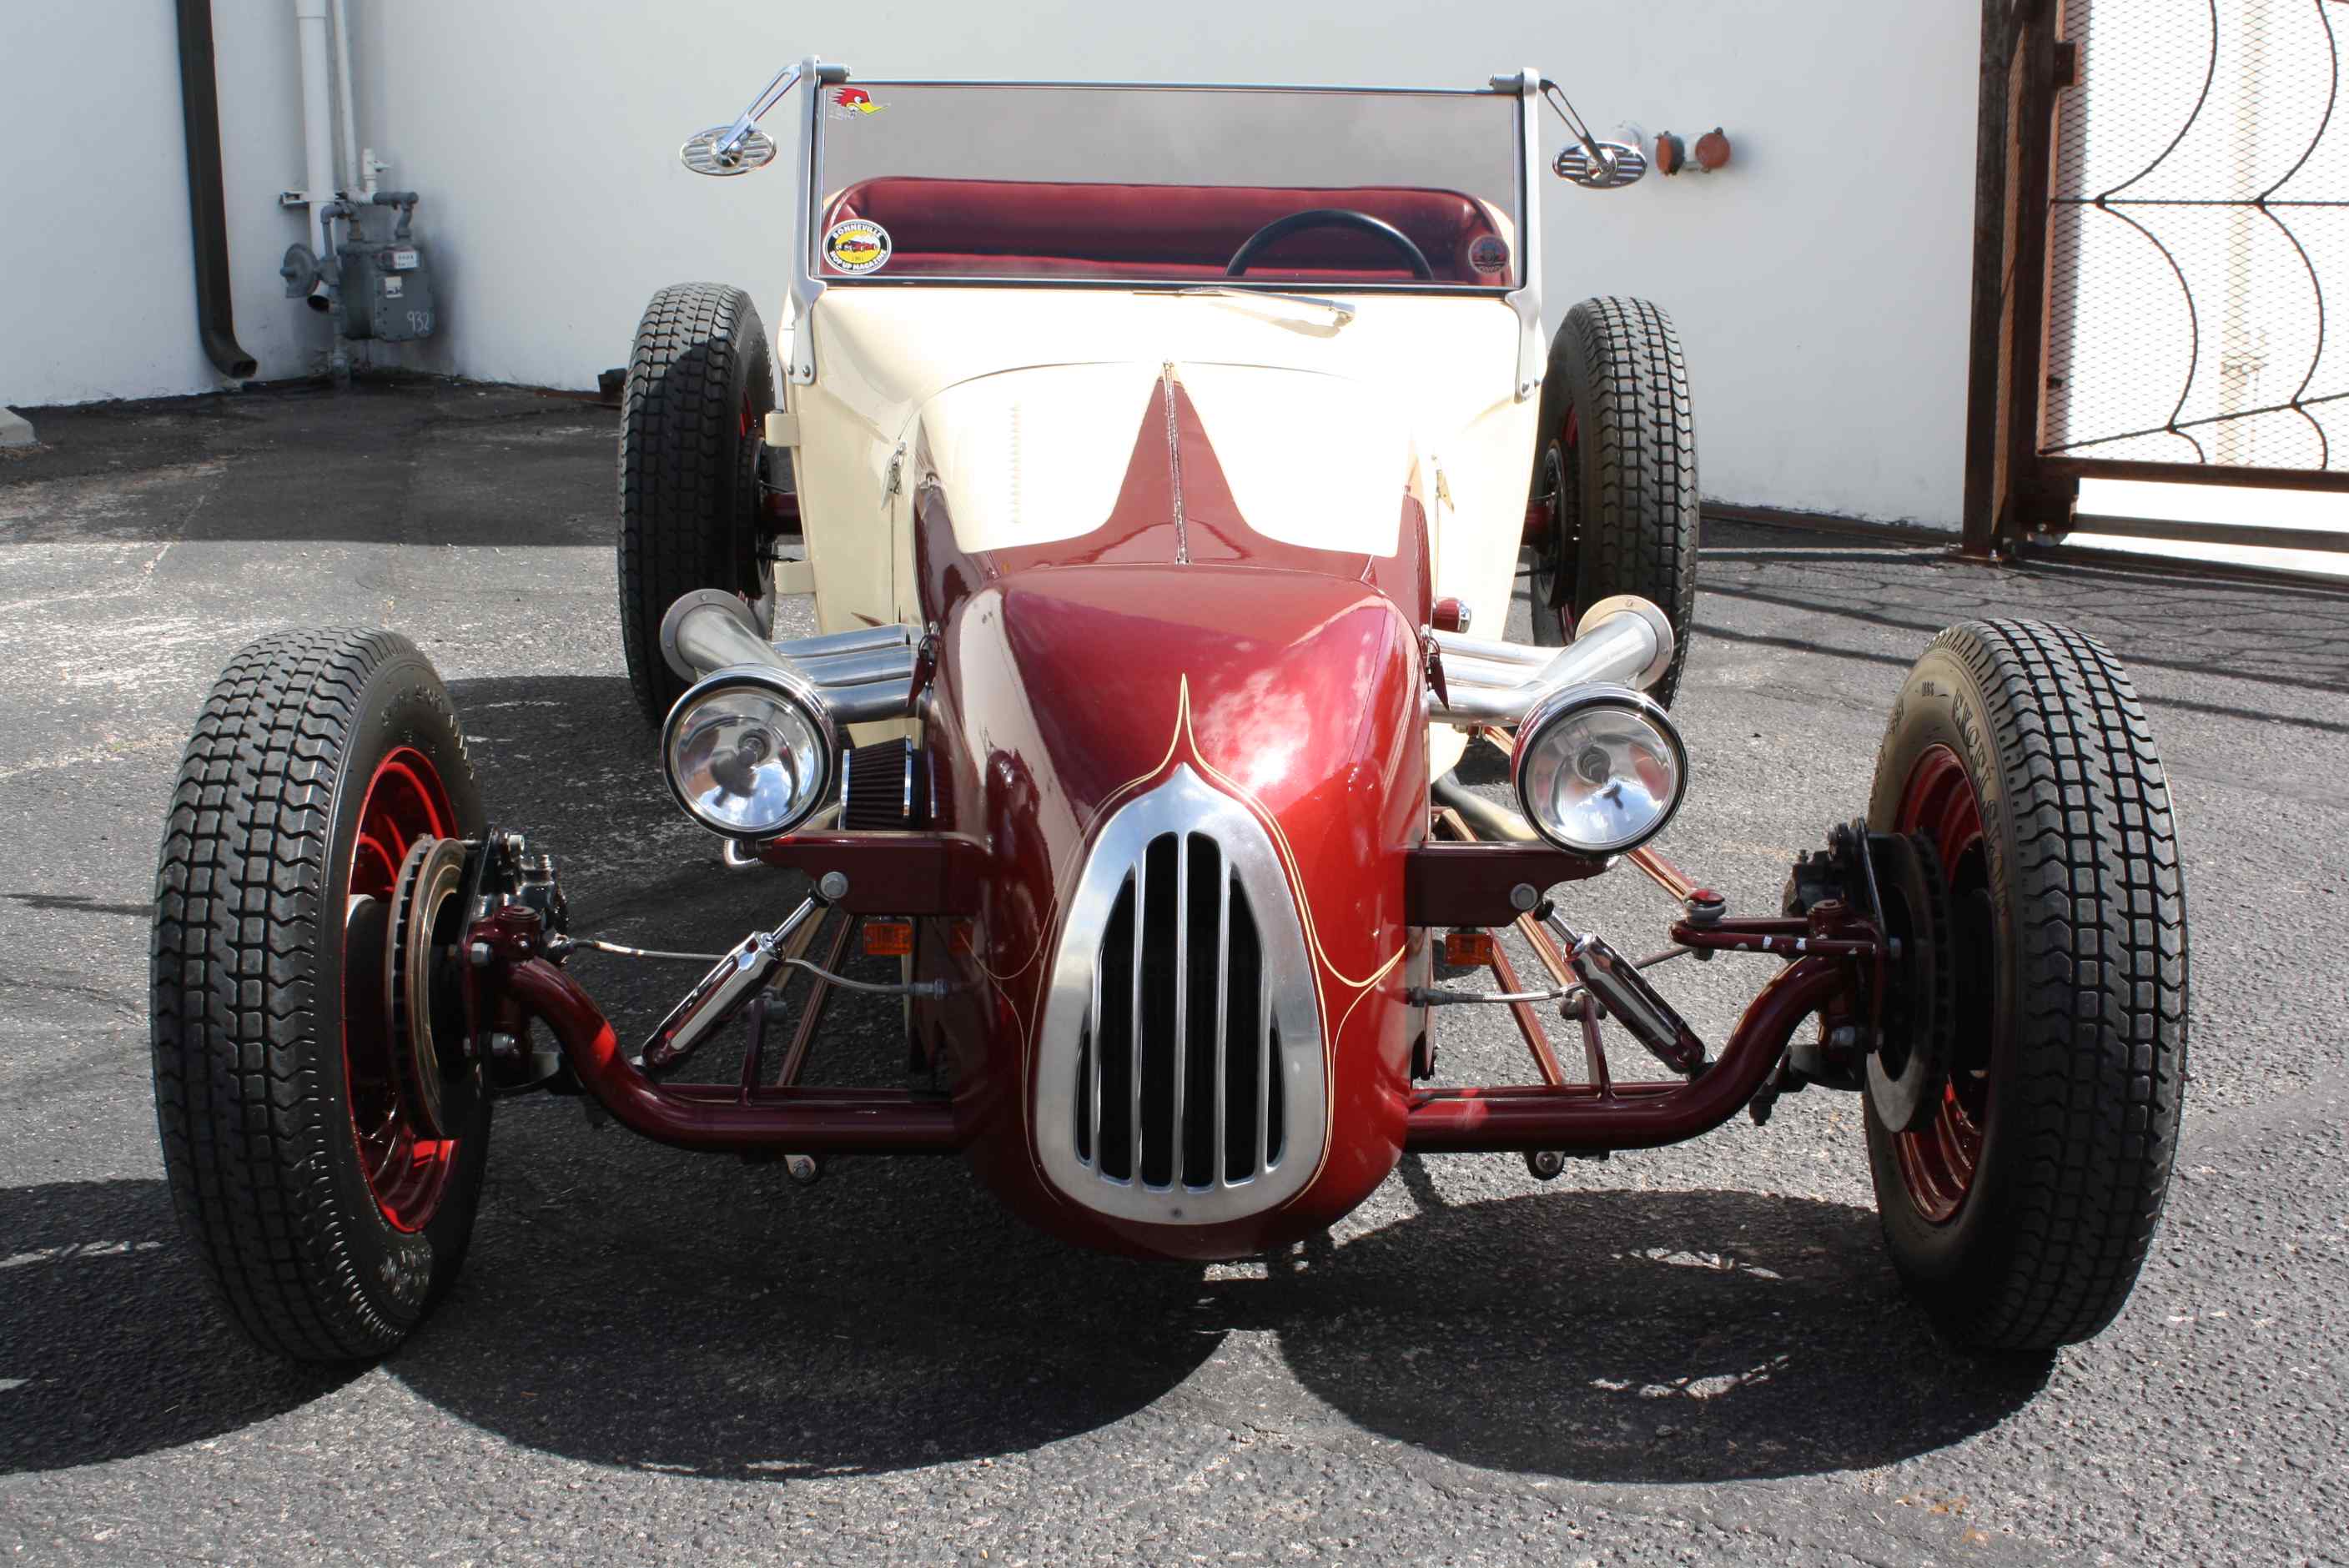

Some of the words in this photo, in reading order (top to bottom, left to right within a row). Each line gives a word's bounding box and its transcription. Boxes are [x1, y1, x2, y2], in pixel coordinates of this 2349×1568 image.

[832, 224, 883, 239] BONNEVILLE
[829, 250, 843, 264] HOP
[842, 261, 853, 269] UP
[853, 249, 887, 269] MAGAZINE
